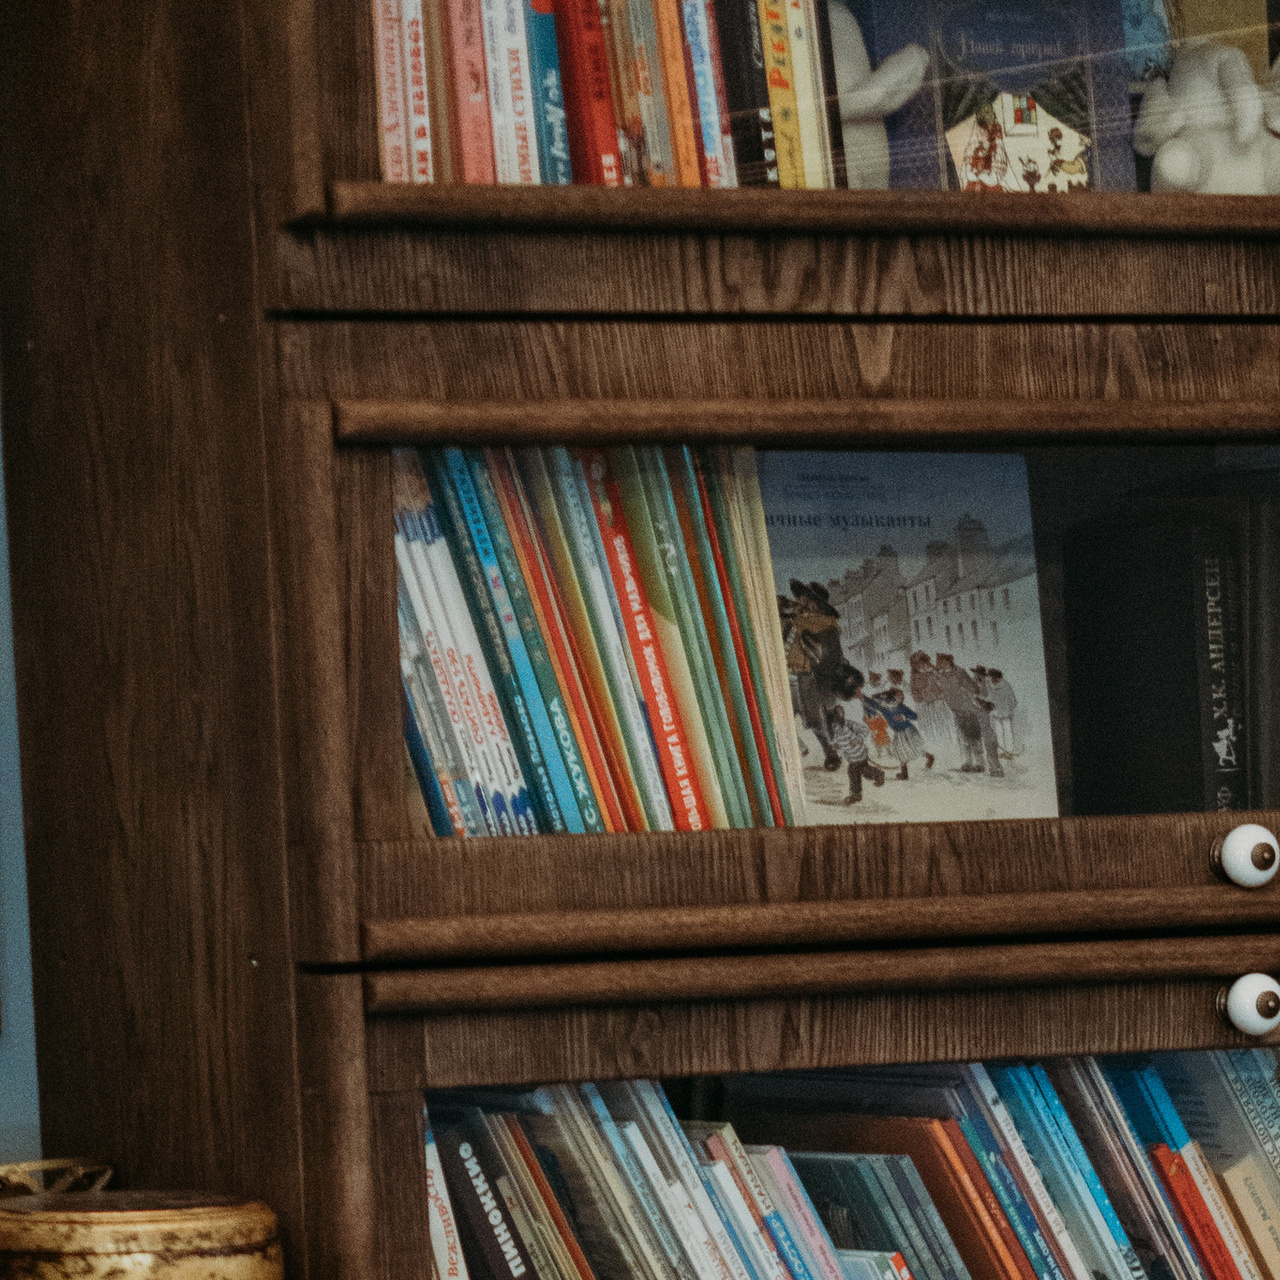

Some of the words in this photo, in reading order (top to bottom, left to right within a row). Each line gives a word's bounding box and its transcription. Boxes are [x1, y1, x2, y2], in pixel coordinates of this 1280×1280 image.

[828, 511, 931, 531] музыканты
[611, 533, 644, 612] МАЛЬЧИКОВ
[633, 612, 652, 641] ДЛЯ
[1204, 556, 1225, 672] АНДЕРСЕН
[456, 678, 484, 746] СЧИТАТЬ
[641, 643, 676, 732] ГОЛОВОЛОМОК
[546, 695, 590, 799] ЖУКОВА
[665, 732, 688, 776] КНИГА
[1228, 1073, 1271, 1146] ПОТЕРЯЛСЯ
[1243, 1074, 1276, 1129] ОГОРОДЕ
[453, 1139, 529, 1278] ПИНОККИО
[1031, 1227, 1050, 1254] ОЗЕРЕ
[1043, 1253, 1057, 1270] НА
